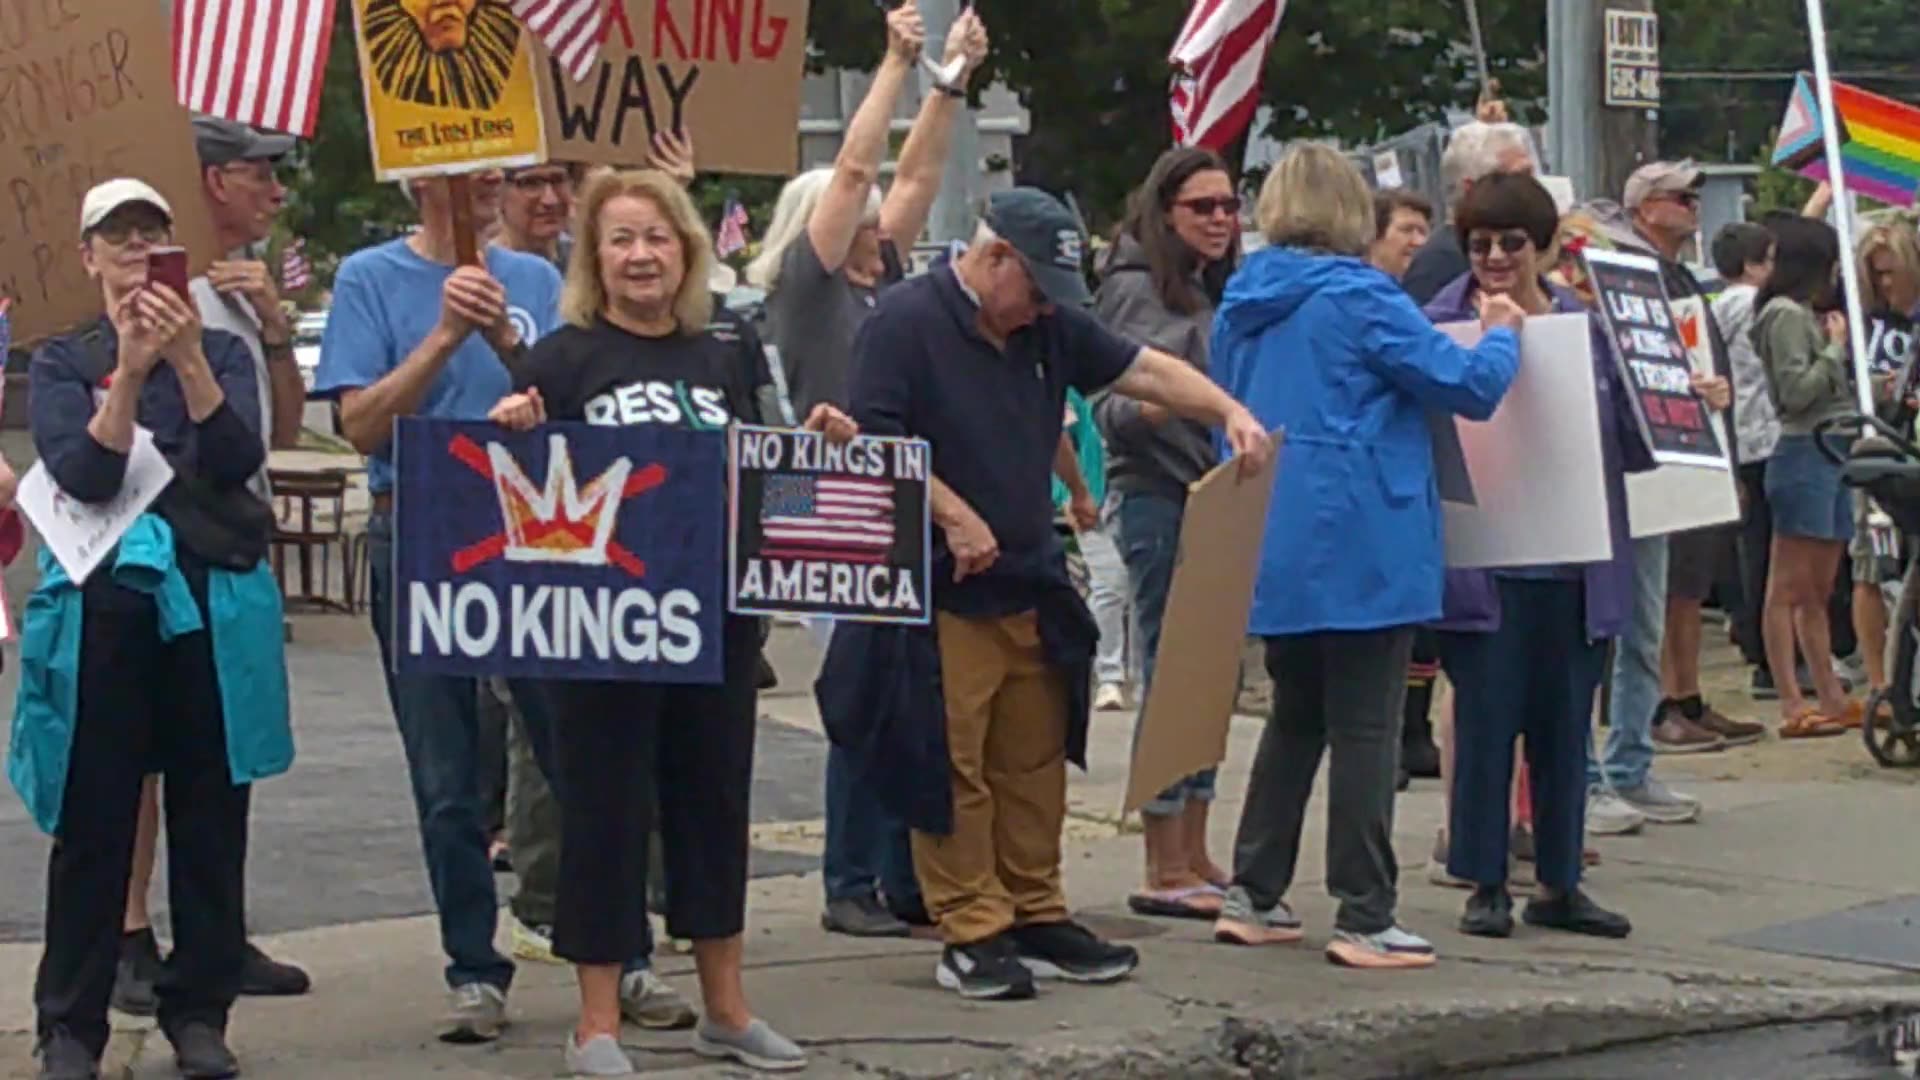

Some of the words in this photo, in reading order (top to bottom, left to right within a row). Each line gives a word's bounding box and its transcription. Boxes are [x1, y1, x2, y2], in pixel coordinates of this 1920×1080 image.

[653, 0, 788, 63] KING
[549, 54, 699, 148] WAY
[741, 433, 783, 470] NO
[791, 433, 886, 477] KINGS
[893, 442, 924, 482] IN
[738, 558, 922, 610] AMERICA
[408, 580, 500, 658] NO
[510, 584, 702, 664] KINGS
